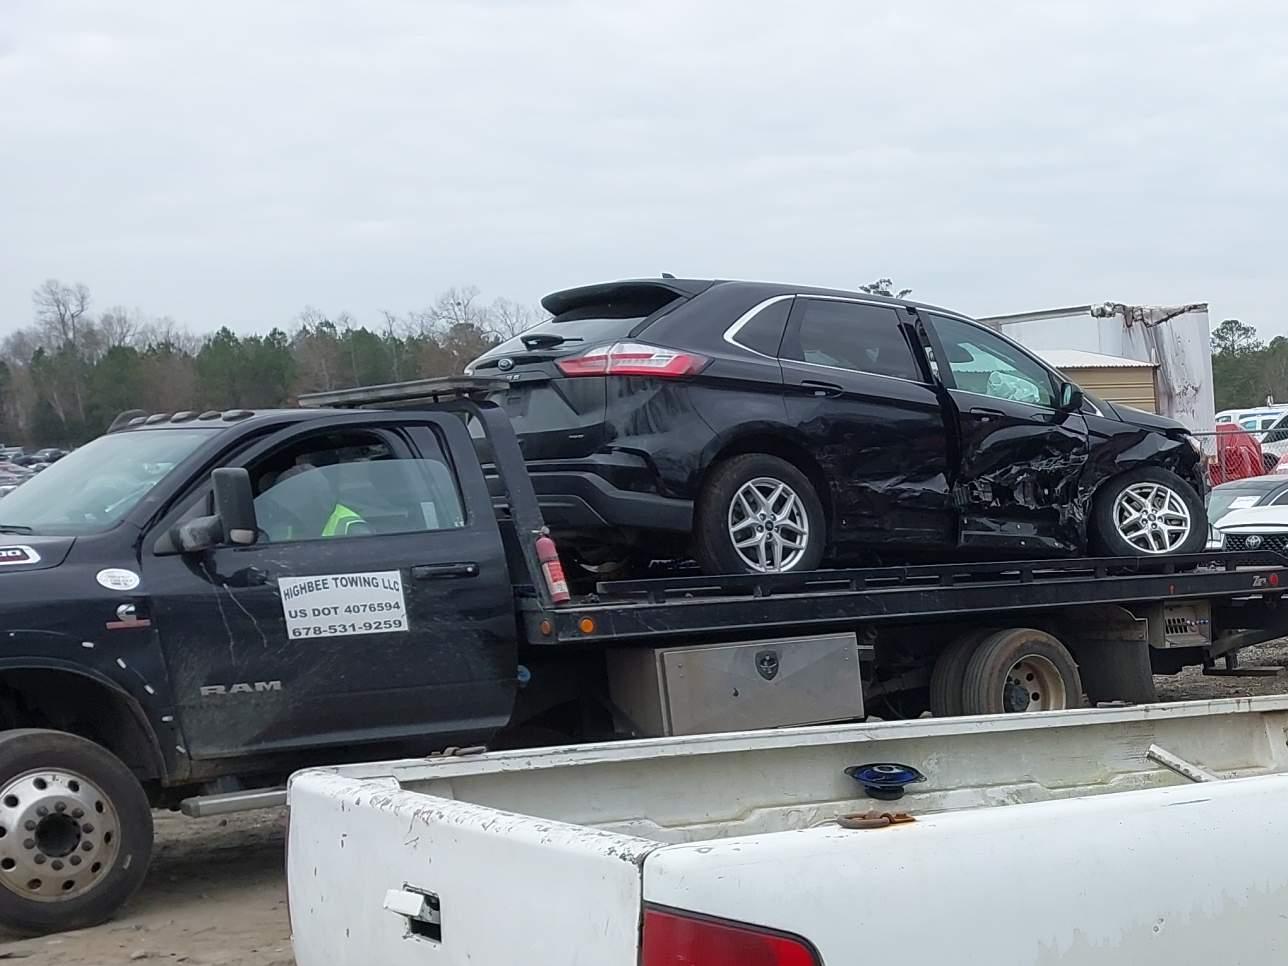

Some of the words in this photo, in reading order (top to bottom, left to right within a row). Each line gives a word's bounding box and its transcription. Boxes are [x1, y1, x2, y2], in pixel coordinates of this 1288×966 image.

[283, 578, 330, 600] HIGHBEE
[331, 576, 379, 588] TOWING
[381, 578, 400, 592] LLC
[288, 608, 308, 619] US
[312, 606, 340, 617] DOT
[343, 601, 401, 614] 4076594
[292, 619, 402, 637] 678-531-9259
[200, 680, 281, 696] RAM
